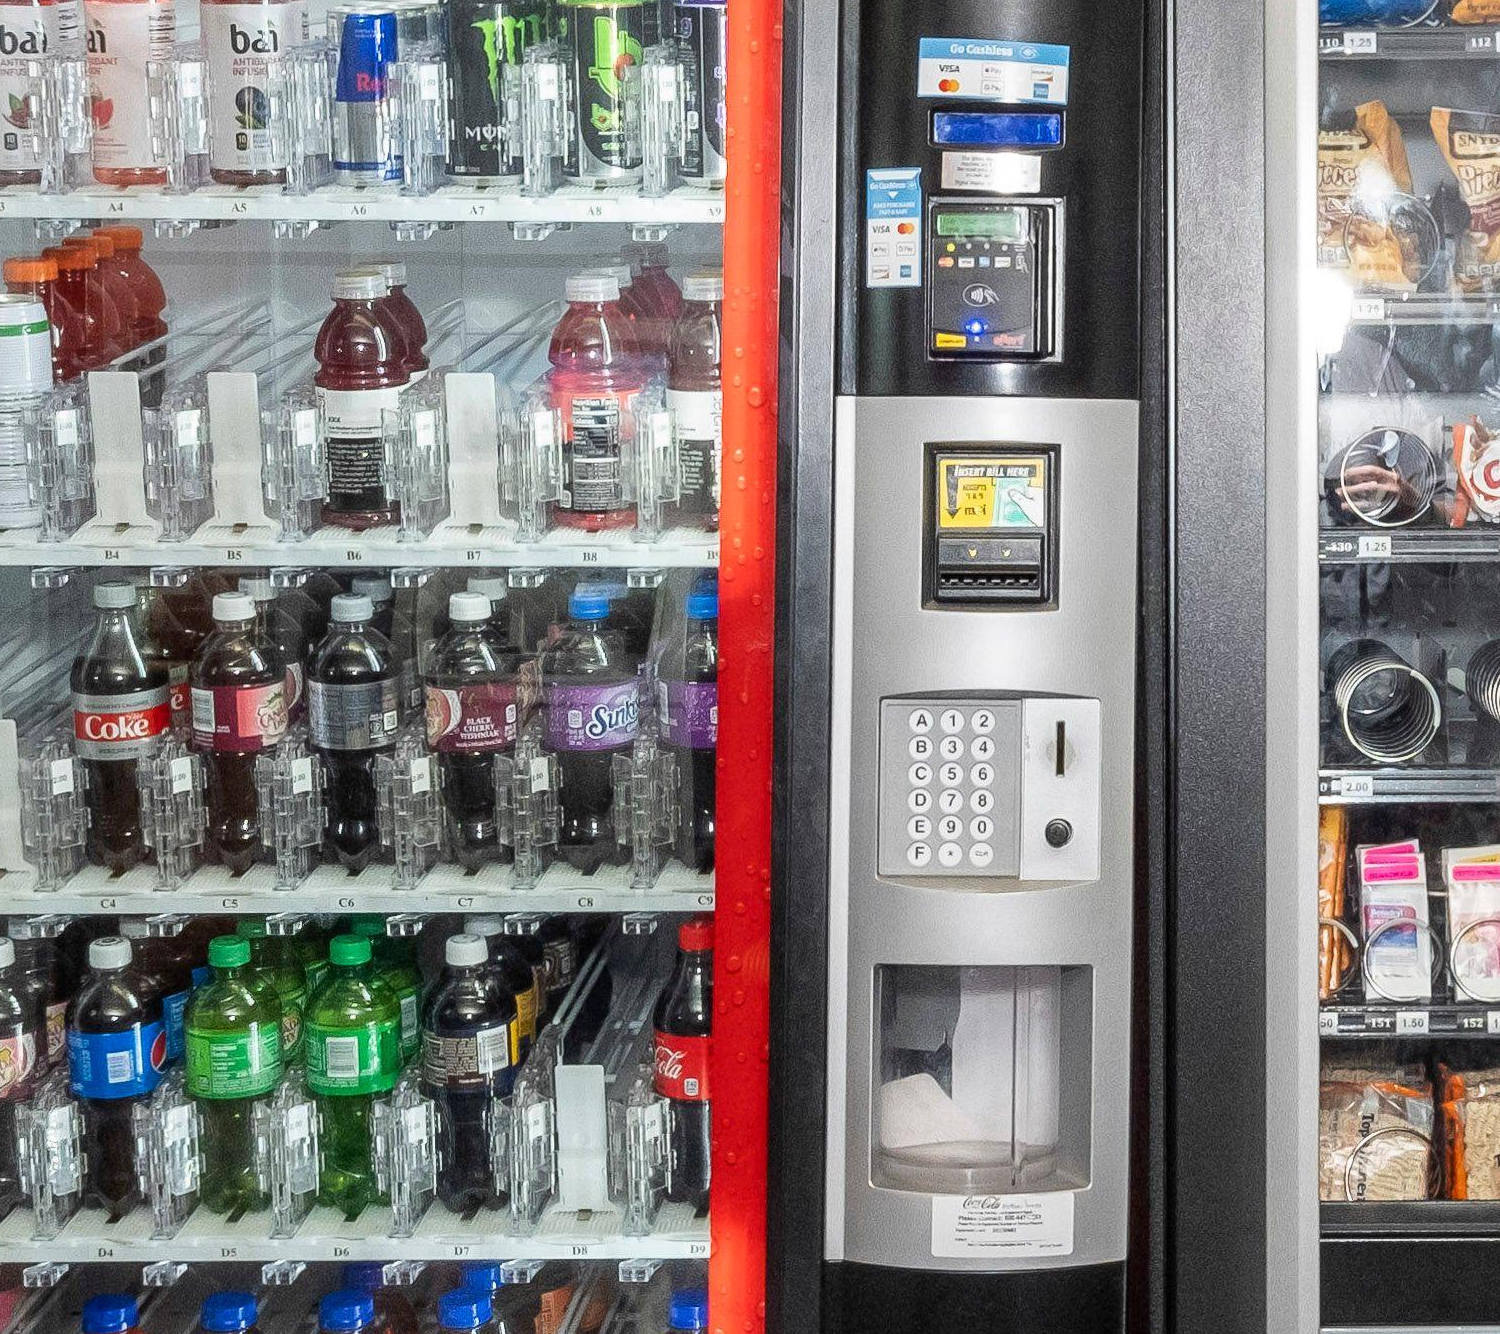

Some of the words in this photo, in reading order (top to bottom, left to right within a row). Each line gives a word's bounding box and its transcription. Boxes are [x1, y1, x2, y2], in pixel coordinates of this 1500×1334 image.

[1350, 36, 1372, 48] 1.25
[950, 44, 964, 54] Go
[967, 44, 1013, 57] Cashless
[939, 64, 960, 73] VISA
[108, 201, 123, 212] A4
[232, 203, 246, 213] A5
[351, 205, 367, 215] A6
[470, 204, 485, 215] A7
[587, 206, 602, 215] A8
[872, 225, 890, 234] VISA
[1357, 303, 1380, 314] 1.25
[955, 466, 985, 476] INSERT
[986, 467, 1005, 476] BILL
[1007, 467, 1029, 476] HERE
[1364, 541, 1387, 551] 1.25
[105, 550, 119, 560] B4
[227, 550, 241, 560] B5
[347, 550, 361, 560] B6
[467, 550, 481, 560] B7
[582, 552, 597, 562] B8
[84, 707, 150, 741] Coke
[467, 717, 491, 725] BLACK
[463, 724, 495, 732] CHERRY
[1346, 782, 1368, 792] 2.00
[100, 899, 116, 909] C4
[222, 898, 238, 908] C5
[339, 897, 354, 908] C6
[458, 897, 473, 907] C7
[578, 897, 593, 907] C8
[697, 895, 713, 905] C9
[1371, 1017, 1391, 1028] 151
[1402, 1018, 1424, 1028] 1.50
[1463, 1017, 1484, 1028] 152
[97, 1248, 113, 1259] D4
[221, 1247, 237, 1258] D5
[334, 1247, 349, 1257] D6
[454, 1246, 469, 1256] D7
[572, 1246, 587, 1256] D8
[690, 1244, 705, 1255] D9
